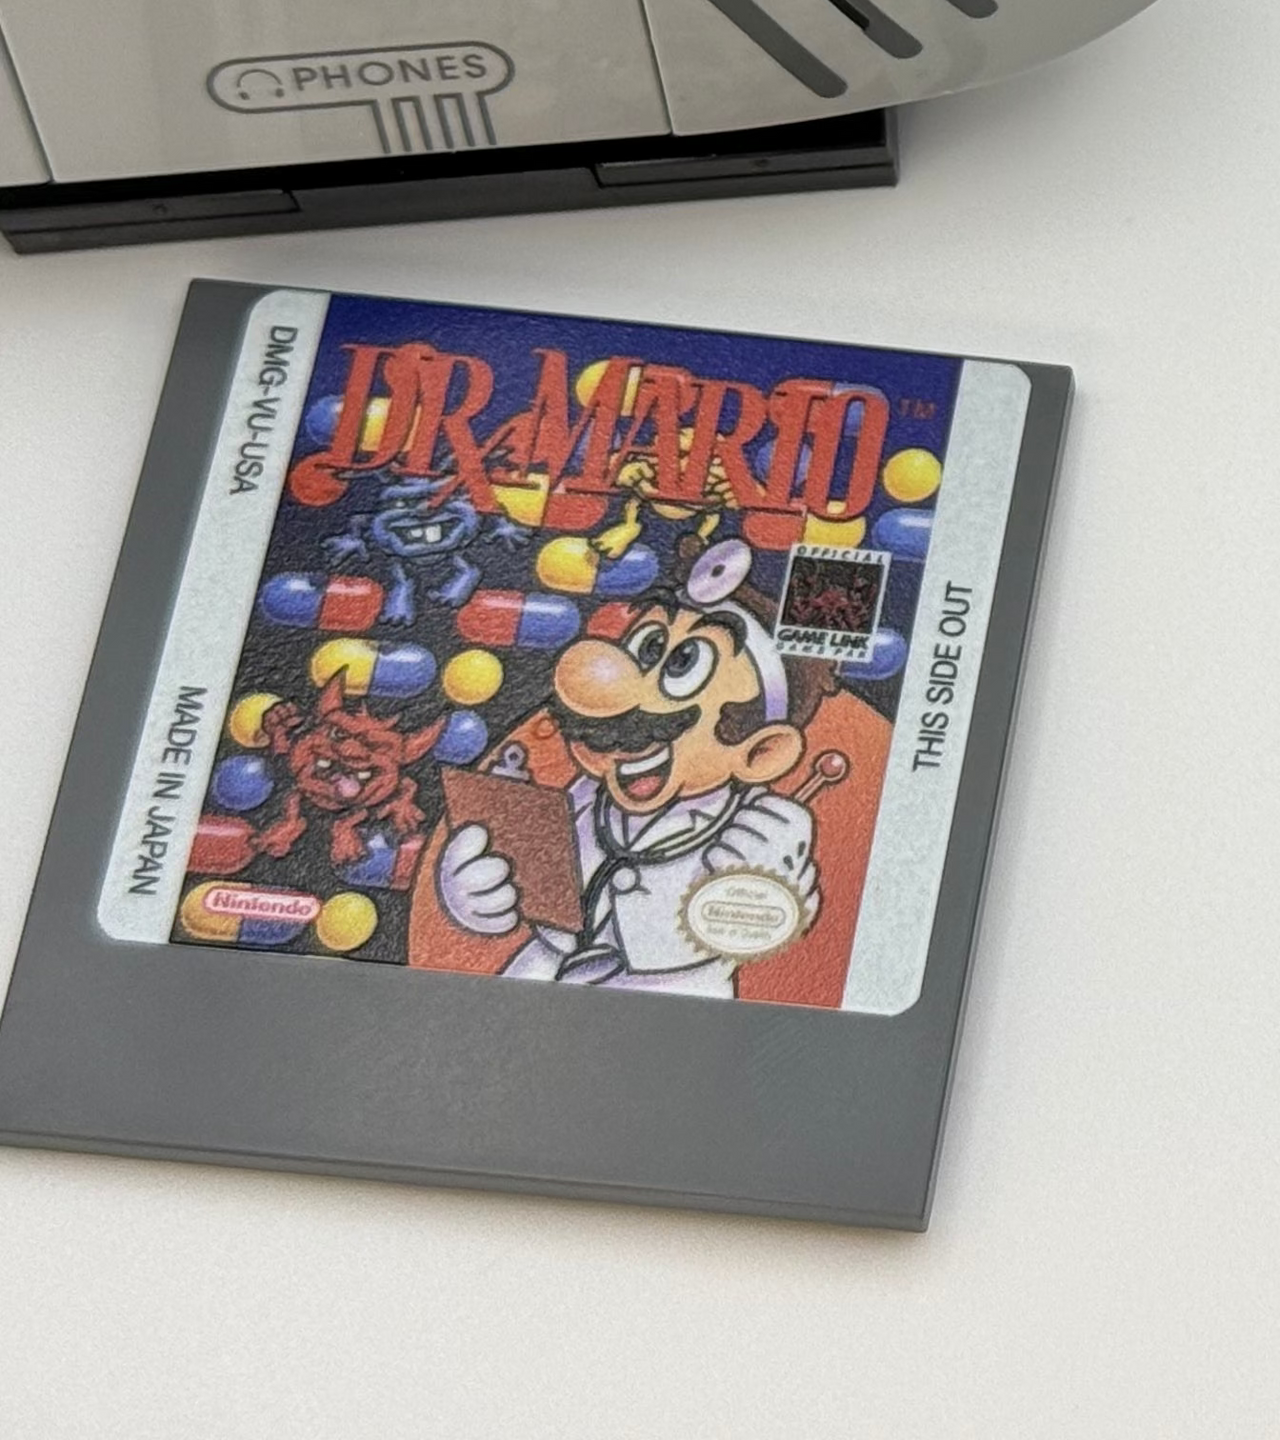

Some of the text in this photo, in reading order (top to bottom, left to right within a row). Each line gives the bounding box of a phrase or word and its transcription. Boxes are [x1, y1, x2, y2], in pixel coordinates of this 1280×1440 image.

[293, 53, 486, 91] PHONES
[229, 325, 298, 495] DMG-VU-USA
[490, 347, 890, 520] MARIO
[912, 580, 973, 773] THIS SIDE OUT
[128, 685, 208, 896] MADE IN JAPAN
[213, 892, 312, 916] Nintendo
